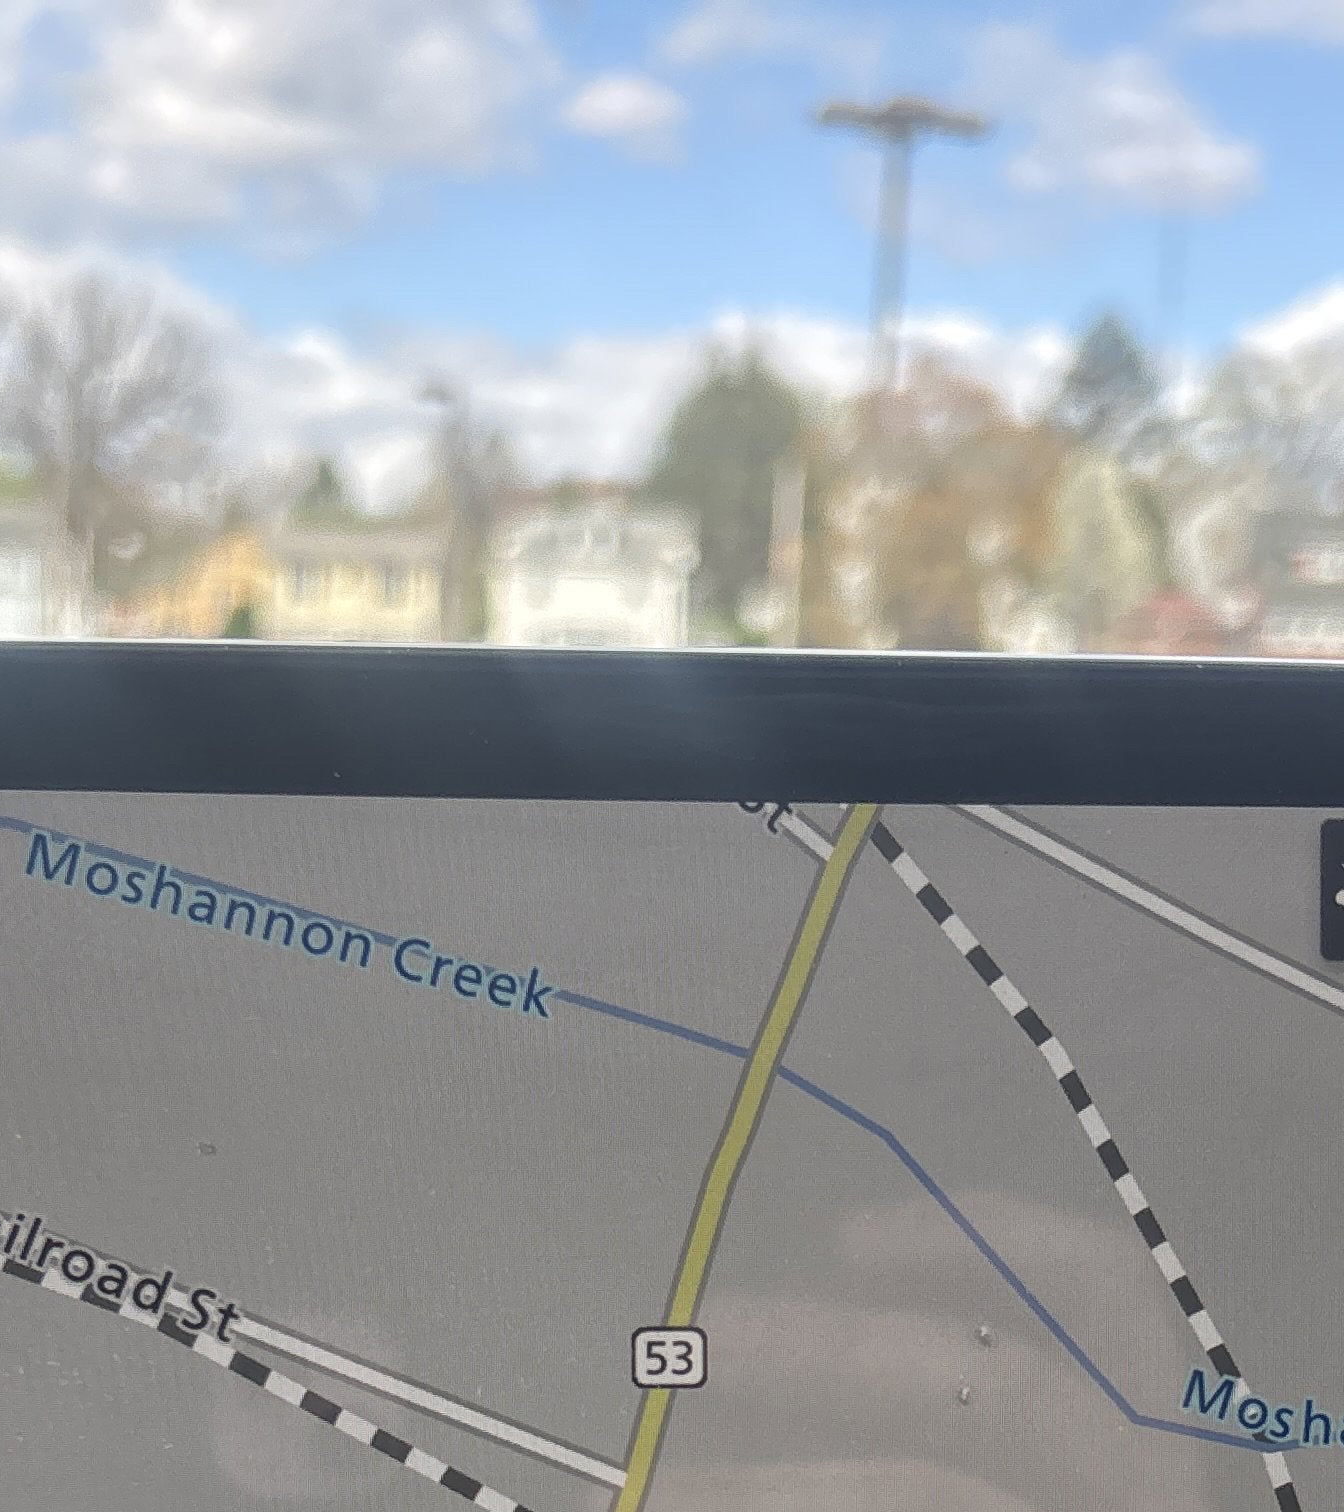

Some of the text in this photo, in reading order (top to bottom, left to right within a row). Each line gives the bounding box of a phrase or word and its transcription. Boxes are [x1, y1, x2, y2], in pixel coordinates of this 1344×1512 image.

[24, 833, 554, 1018] Moshannon Creek
[180, 1286, 244, 1344] St
[645, 1340, 694, 1376] 53
